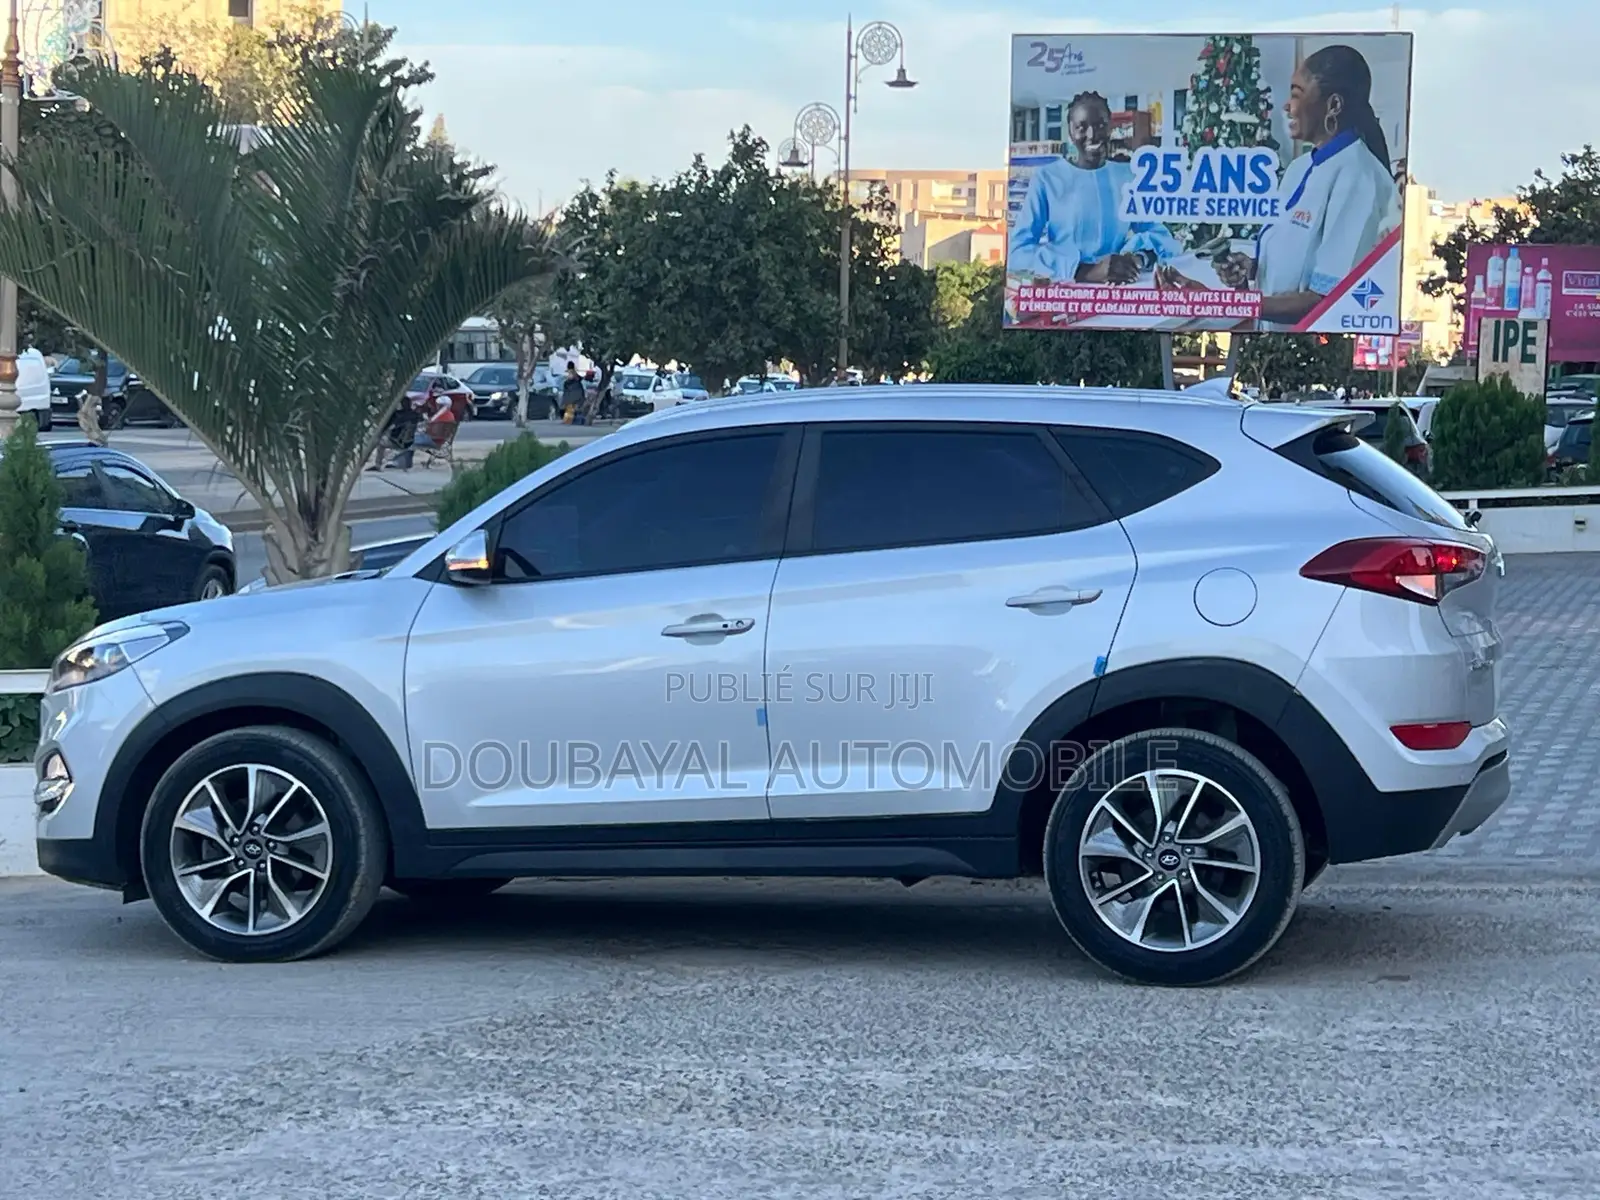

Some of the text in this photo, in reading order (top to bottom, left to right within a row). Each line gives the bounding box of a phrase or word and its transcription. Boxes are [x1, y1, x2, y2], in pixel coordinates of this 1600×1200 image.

[1027, 42, 1064, 73] 25
[1136, 152, 1273, 194] 25 ANS
[1126, 189, 1279, 217] À VOTRE SERVICE
[1020, 287, 1033, 298] DU
[1035, 288, 1046, 299] 01
[1047, 285, 1095, 300] DÉCEMBRE
[1096, 289, 1109, 300] AU
[1111, 289, 1120, 300] 15
[1122, 290, 1159, 301] JANVIER
[1188, 291, 1219, 302] FAITES
[1221, 291, 1232, 303] LE
[1234, 292, 1261, 304] PLEIN
[1068, 301, 1080, 312] ET
[1081, 302, 1093, 313] DE
[1094, 302, 1137, 314] CADEAUX
[1138, 303, 1161, 315] AVEC
[1162, 304, 1192, 315] VOTRE
[1193, 305, 1224, 316] CARTE
[1225, 306, 1252, 317] OASIS
[1341, 315, 1392, 329] ELTON
[1492, 320, 1538, 363] IPE
